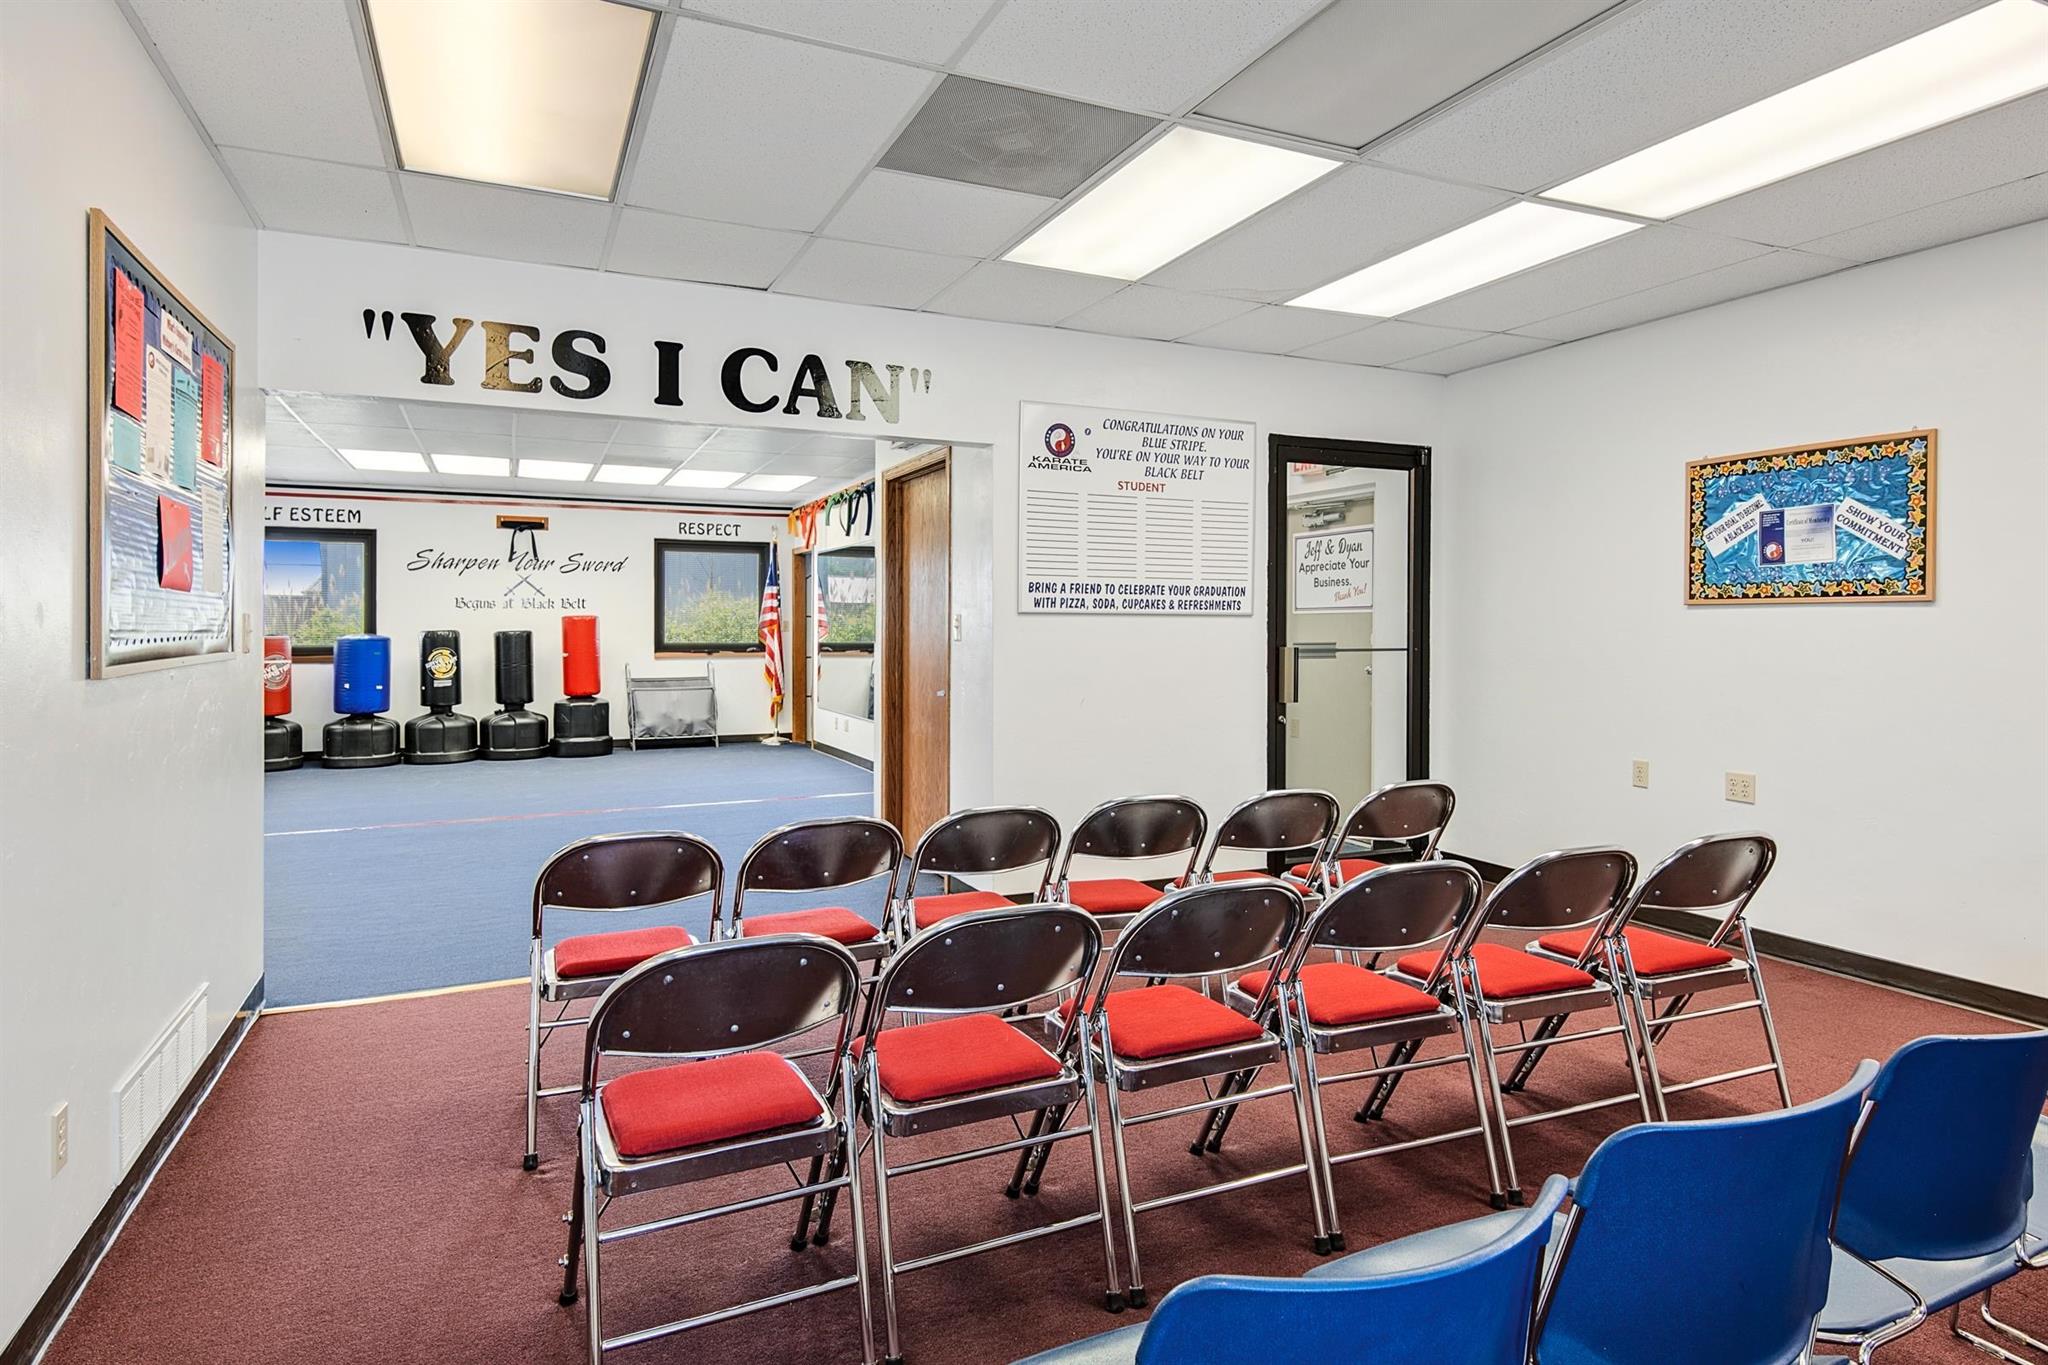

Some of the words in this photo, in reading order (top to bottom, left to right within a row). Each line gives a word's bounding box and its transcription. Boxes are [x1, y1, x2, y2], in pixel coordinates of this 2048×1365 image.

[363, 308, 611, 400] "YES
[654, 340, 684, 406] I
[720, 347, 933, 424] CAN"
[1102, 418, 1199, 437] CONGRATULATIONS
[1201, 427, 1216, 439] ON
[1219, 429, 1245, 441] YOUR
[1142, 436, 1168, 449] BLUE
[1170, 439, 1207, 453] STRIPE.
[1032, 455, 1088, 465] KARATE
[1096, 448, 1133, 461] YOU'RE
[1135, 450, 1151, 462] ON
[1154, 452, 1181, 464] YOUR
[1184, 455, 1207, 467] WAY
[1210, 456, 1221, 468] TO
[1224, 458, 1250, 470] YOUR
[1027, 462, 1092, 473] AMERICA
[1144, 466, 1177, 479] BLACK
[1180, 470, 1204, 481] BELT
[1117, 480, 1166, 493] STUDENT
[290, 507, 361, 524] ESTEEM
[1736, 511, 1745, 521] TO
[1846, 505, 1879, 525] SHOW
[1877, 520, 1907, 542] YOUR
[678, 522, 741, 537] RESPECT
[1836, 513, 1904, 553] COMMITMENT
[1304, 540, 1323, 562] Jeff
[1325, 538, 1335, 555] &
[1338, 537, 1363, 560] Dyan
[406, 548, 500, 576] Sharpen
[512, 551, 555, 571] Your
[559, 552, 629, 574] Sword
[1299, 560, 1347, 575] Appreciate
[1349, 558, 1370, 569] Your
[1028, 581, 1058, 593] BRING
[1060, 582, 1067, 594] A
[1069, 583, 1102, 595] FRIEND
[1104, 583, 1116, 595] TO
[1117, 584, 1166, 596] CELEBRATE
[1168, 585, 1191, 596] YOUR
[1193, 585, 1246, 597] GRADUATION
[1313, 577, 1352, 588] Business.
[455, 596, 497, 611] Begins
[502, 597, 513, 609] at
[521, 597, 555, 609] Black
[561, 597, 587, 609] Belt
[1033, 597, 1057, 609] WITH
[1059, 597, 1089, 611] PIZZA,
[1092, 598, 1119, 611] SODA,
[1122, 598, 1166, 610] CUPCAKES
[1168, 599, 1175, 610] &
[1177, 599, 1242, 611] REFRESHMENTS
